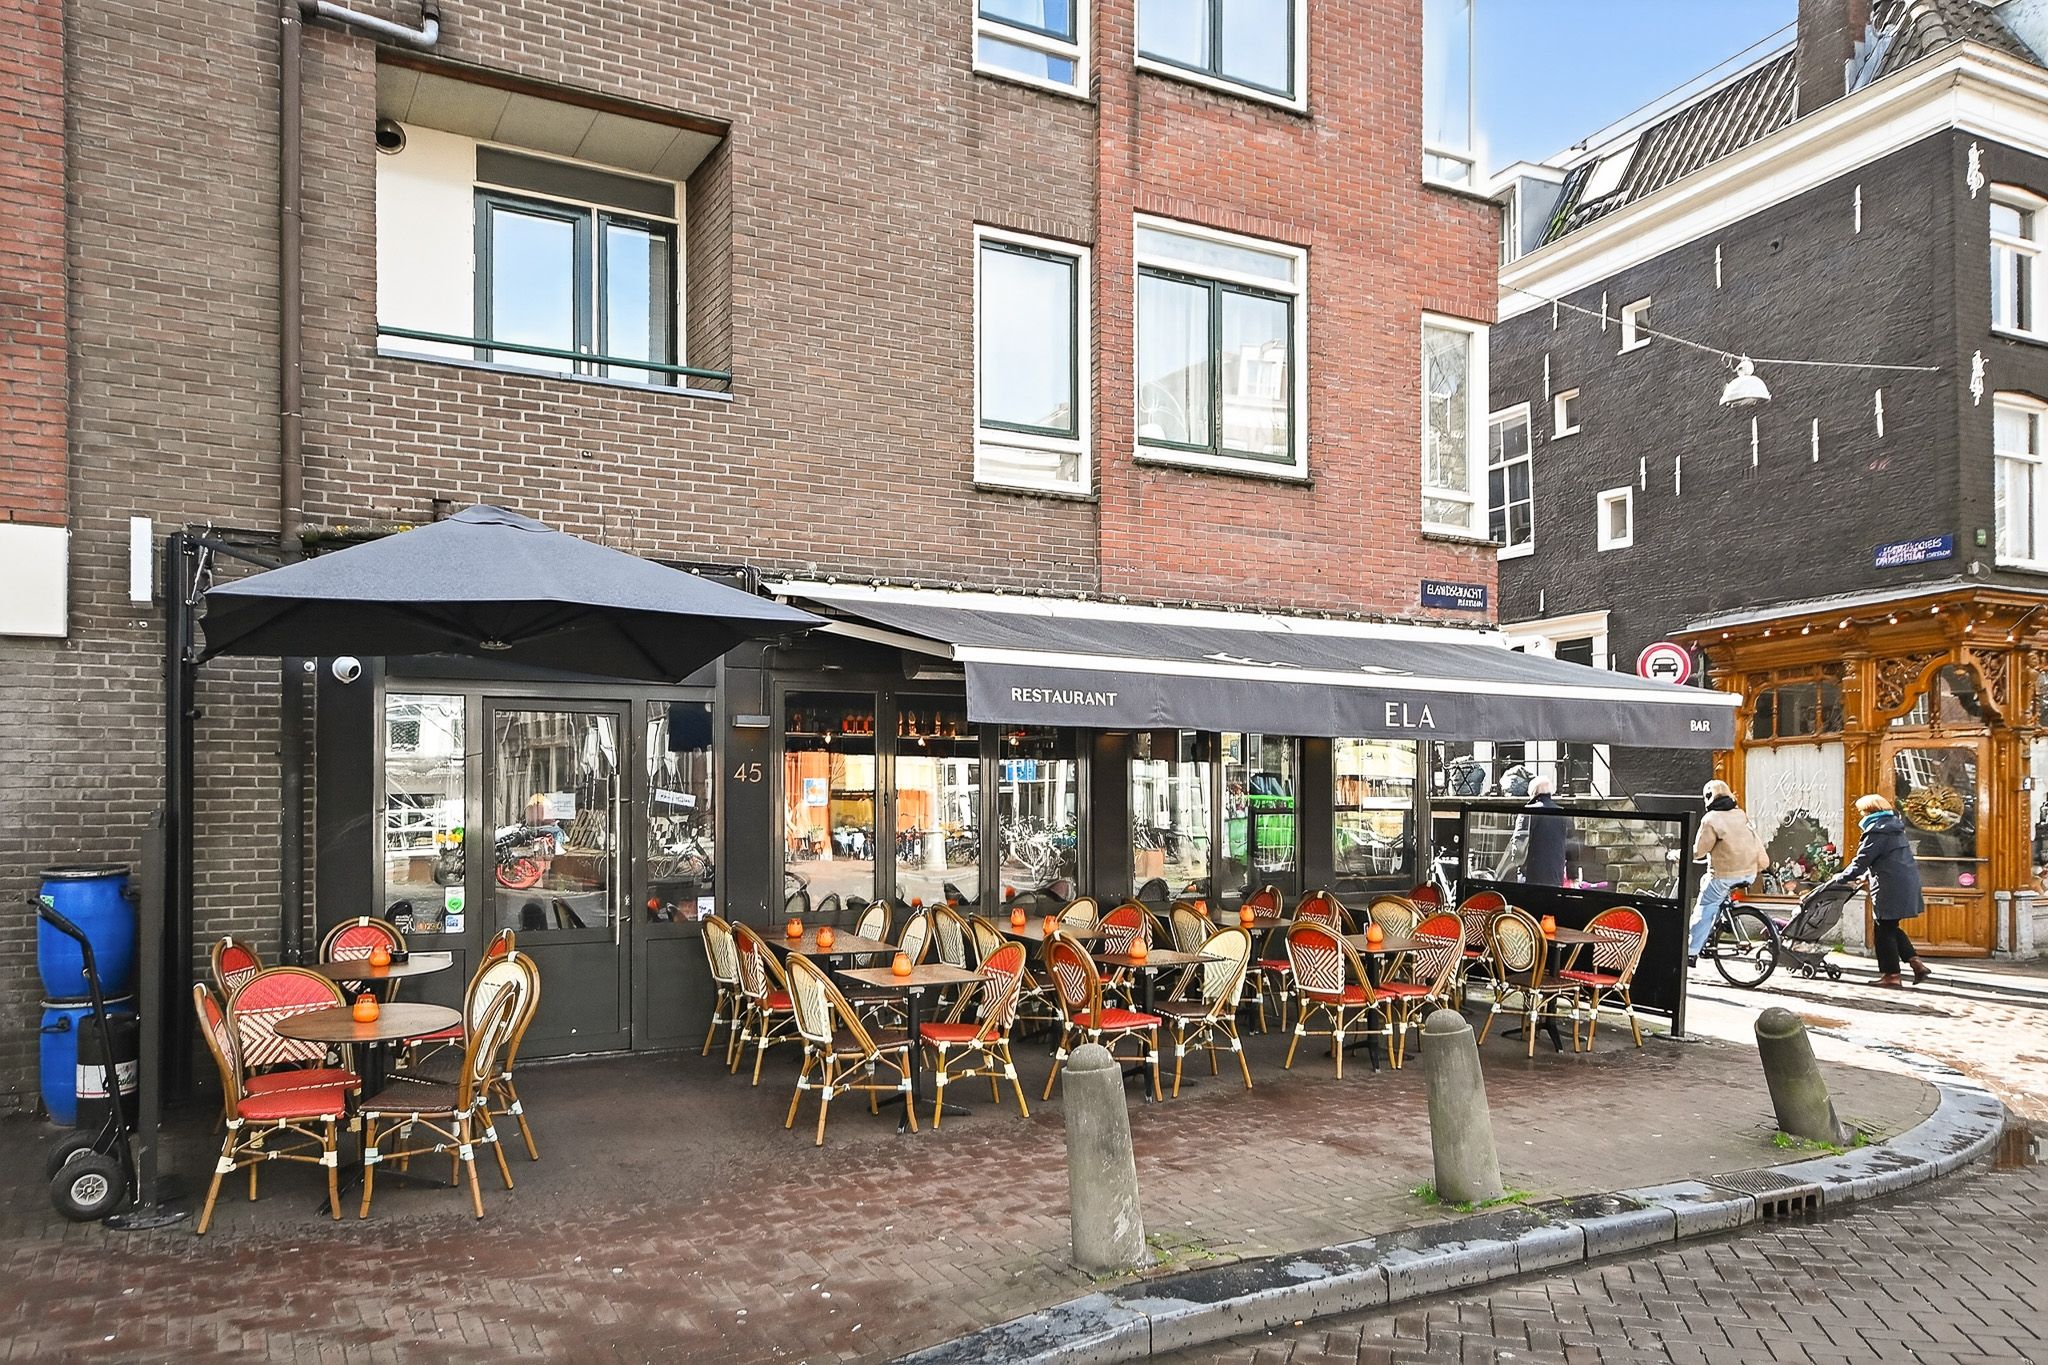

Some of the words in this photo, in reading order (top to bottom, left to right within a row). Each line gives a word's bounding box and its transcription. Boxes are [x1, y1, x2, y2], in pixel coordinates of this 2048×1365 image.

[1011, 687, 1118, 707] RESTAURANT
[1385, 701, 1436, 729] ELA
[1690, 719, 1711, 732] BAR
[733, 762, 762, 783] 45
